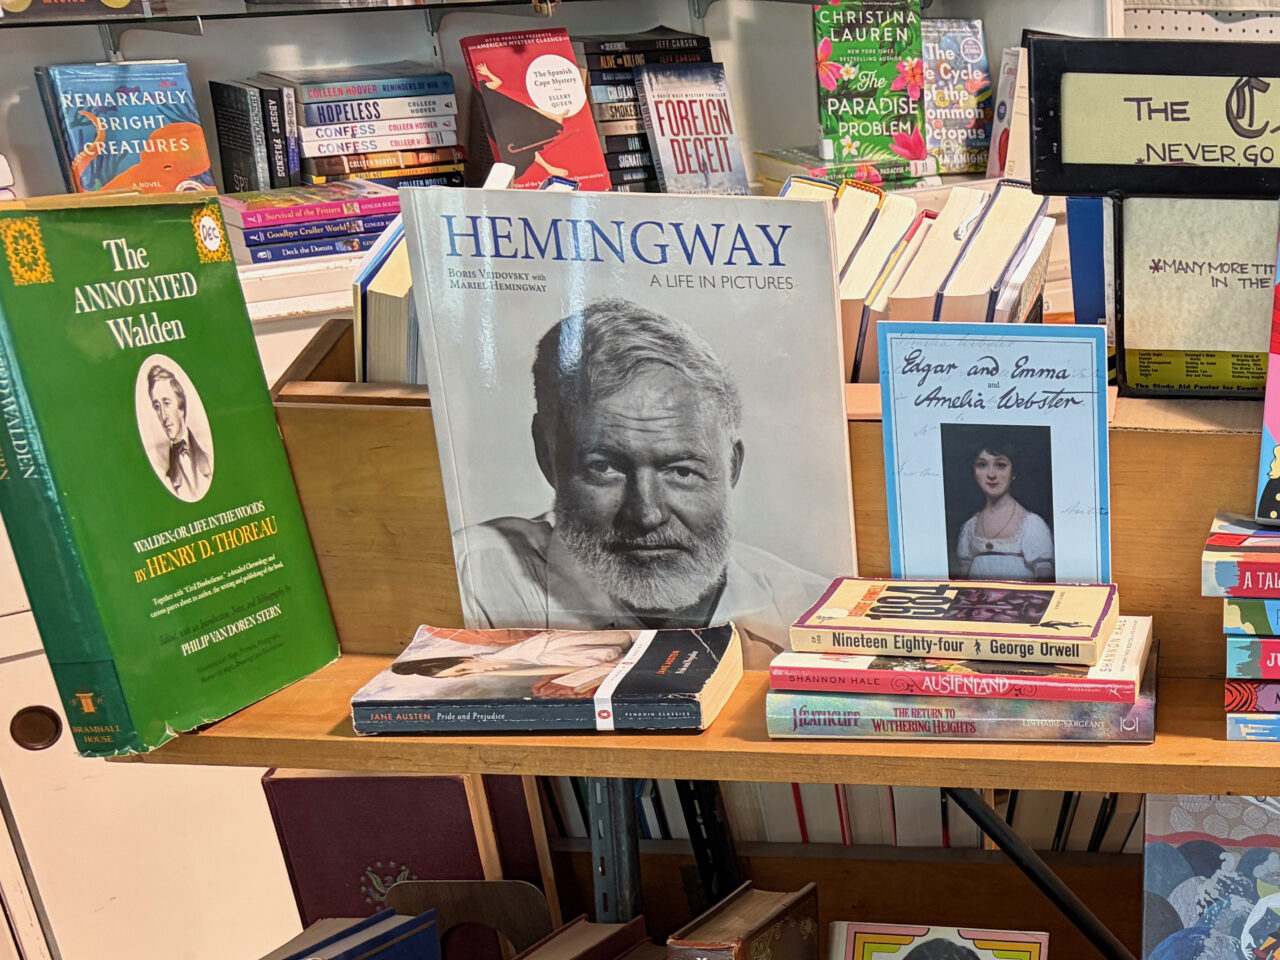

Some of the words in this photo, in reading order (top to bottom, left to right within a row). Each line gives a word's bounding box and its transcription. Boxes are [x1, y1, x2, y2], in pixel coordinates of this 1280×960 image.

[820, 11, 917, 24] CHRISTINA
[830, 28, 907, 41] LAUREN
[534, 78, 550, 88] Cape
[551, 76, 576, 86] Mystery
[547, 68, 572, 77] Spanish
[858, 70, 886, 91] The
[62, 90, 188, 108] REMARKABLY
[307, 88, 344, 99] COLLEEN
[346, 85, 378, 95] HOOVER
[316, 102, 381, 124] HOPELESS
[828, 98, 919, 114] PARADISE
[1124, 97, 1190, 122] THE
[98, 115, 165, 130] BRIGHT
[268, 100, 280, 134] ABSENT
[654, 100, 733, 137] FOREIGN
[316, 124, 376, 138] CONFESS
[839, 122, 911, 136] PROBLEM
[84, 138, 190, 156] CREATURES
[670, 137, 732, 174] DECEIT
[1243, 146, 1274, 166] GO
[273, 138, 285, 177] FRIENDS
[265, 209, 294, 220] Survival
[295, 210, 302, 218] of
[316, 207, 341, 216] Fritters
[441, 215, 792, 266] HEMINGWAY
[103, 238, 149, 272] The
[651, 274, 661, 287] A
[667, 275, 694, 288] LIFE
[700, 276, 716, 288] IN
[721, 276, 793, 290] PICTURES
[1211, 277, 1228, 287] IN
[1237, 278, 1271, 289] THE
[74, 272, 197, 314] ANNOTATED
[106, 316, 186, 350] Walden
[902, 349, 957, 387] Edgar
[967, 356, 999, 377] and
[1011, 356, 1070, 380] Emma
[914, 386, 985, 410] Amelia
[997, 387, 1098, 410] Webster
[135, 569, 147, 582] BY
[146, 540, 196, 578] HENRY
[201, 537, 214, 557] D.
[216, 516, 278, 554] THOREAU
[1243, 572, 1252, 589] A
[832, 632, 888, 650] Nineteen
[893, 635, 964, 654] Eighty-four
[990, 639, 1034, 657] George
[1041, 642, 1080, 657] Orwell
[922, 674, 1009, 694] AUSTENLAND
[437, 712, 455, 720] Pride
[458, 712, 471, 720] and
[473, 711, 505, 722] Prejudice
[792, 705, 860, 731] HEATHCLIFF
[872, 717, 931, 733] WUTHERING
[933, 719, 976, 733] HEIGHTS
